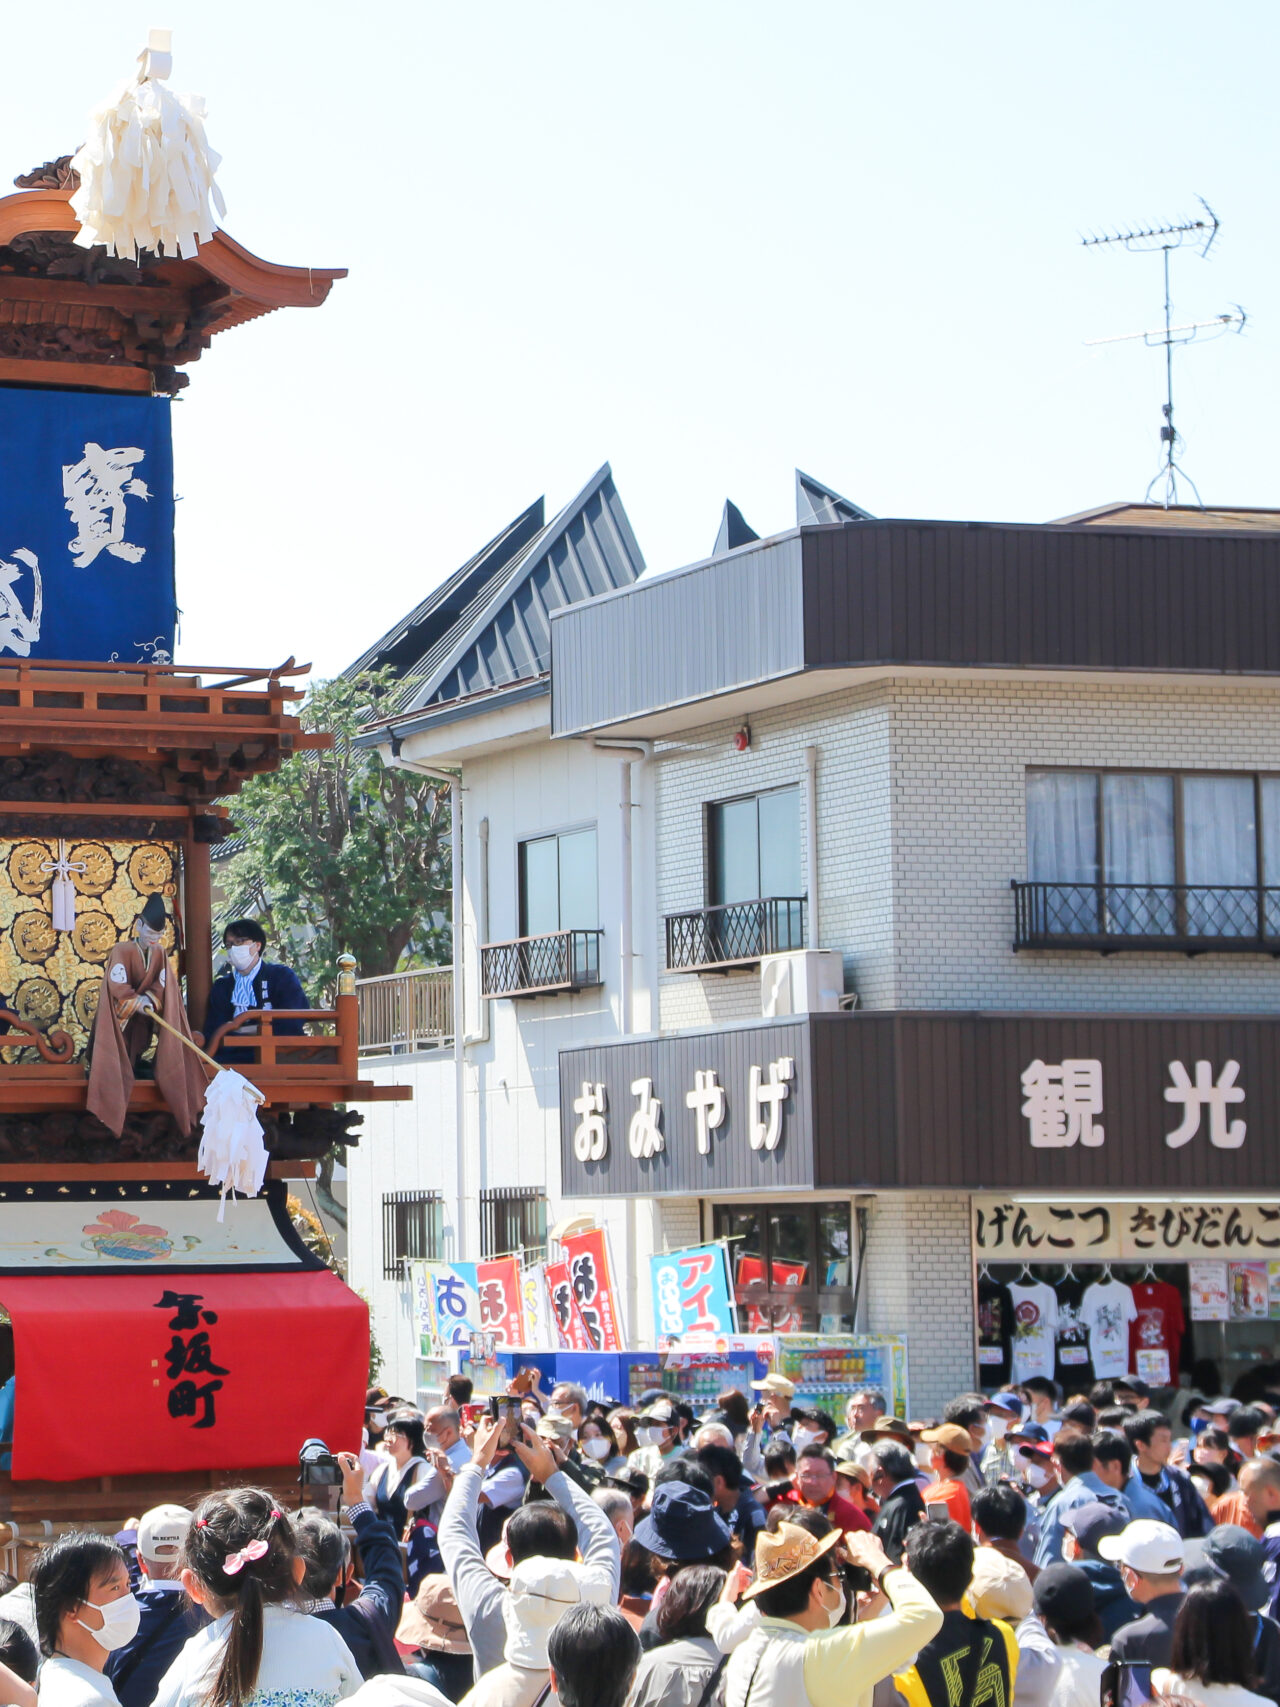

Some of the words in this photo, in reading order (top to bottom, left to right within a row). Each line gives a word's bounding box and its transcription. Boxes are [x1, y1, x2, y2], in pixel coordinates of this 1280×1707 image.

[574, 1057, 794, 1162] おみやげ
[1021, 1058, 1246, 1149] 観光
[976, 1204, 1111, 1249] げんこつ
